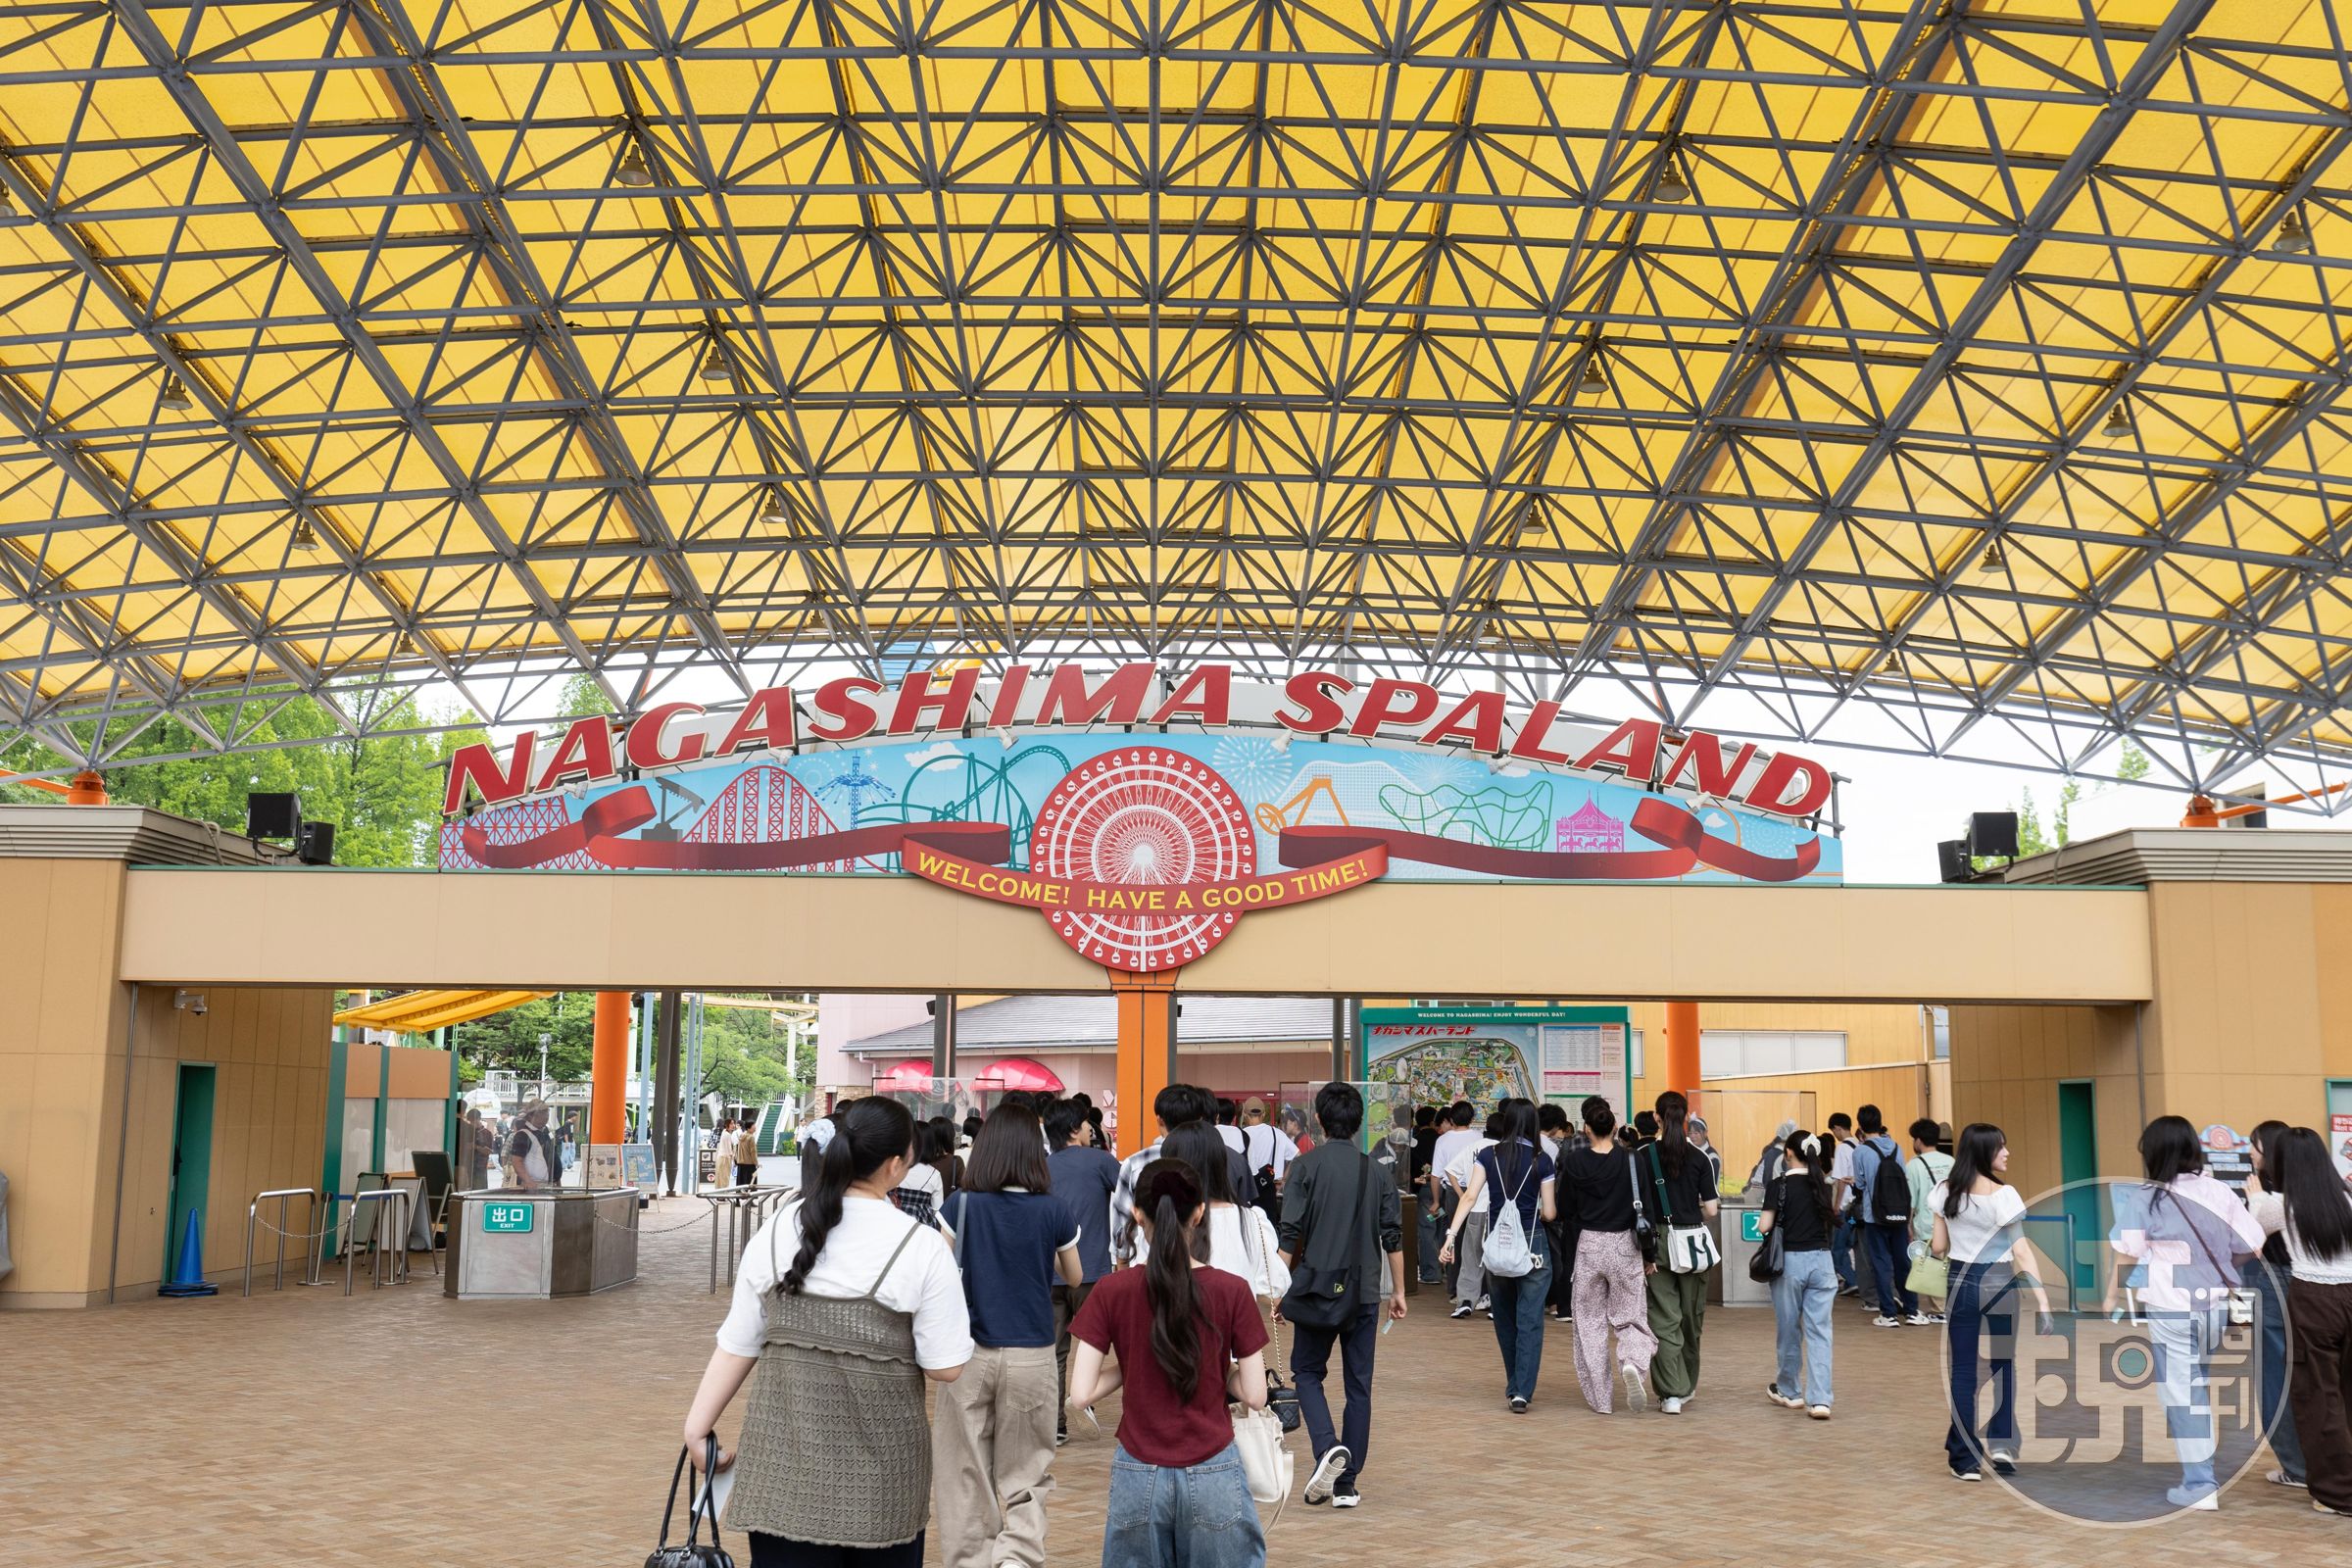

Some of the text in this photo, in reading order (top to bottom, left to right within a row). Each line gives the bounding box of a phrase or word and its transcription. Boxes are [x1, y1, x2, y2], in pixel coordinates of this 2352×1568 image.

[443, 662, 1833, 816] NAGASHIMA SPALAND
[917, 851, 1370, 910] WELCOME! HAVE A GOOD TIME!
[492, 1206, 524, 1222] 出口
